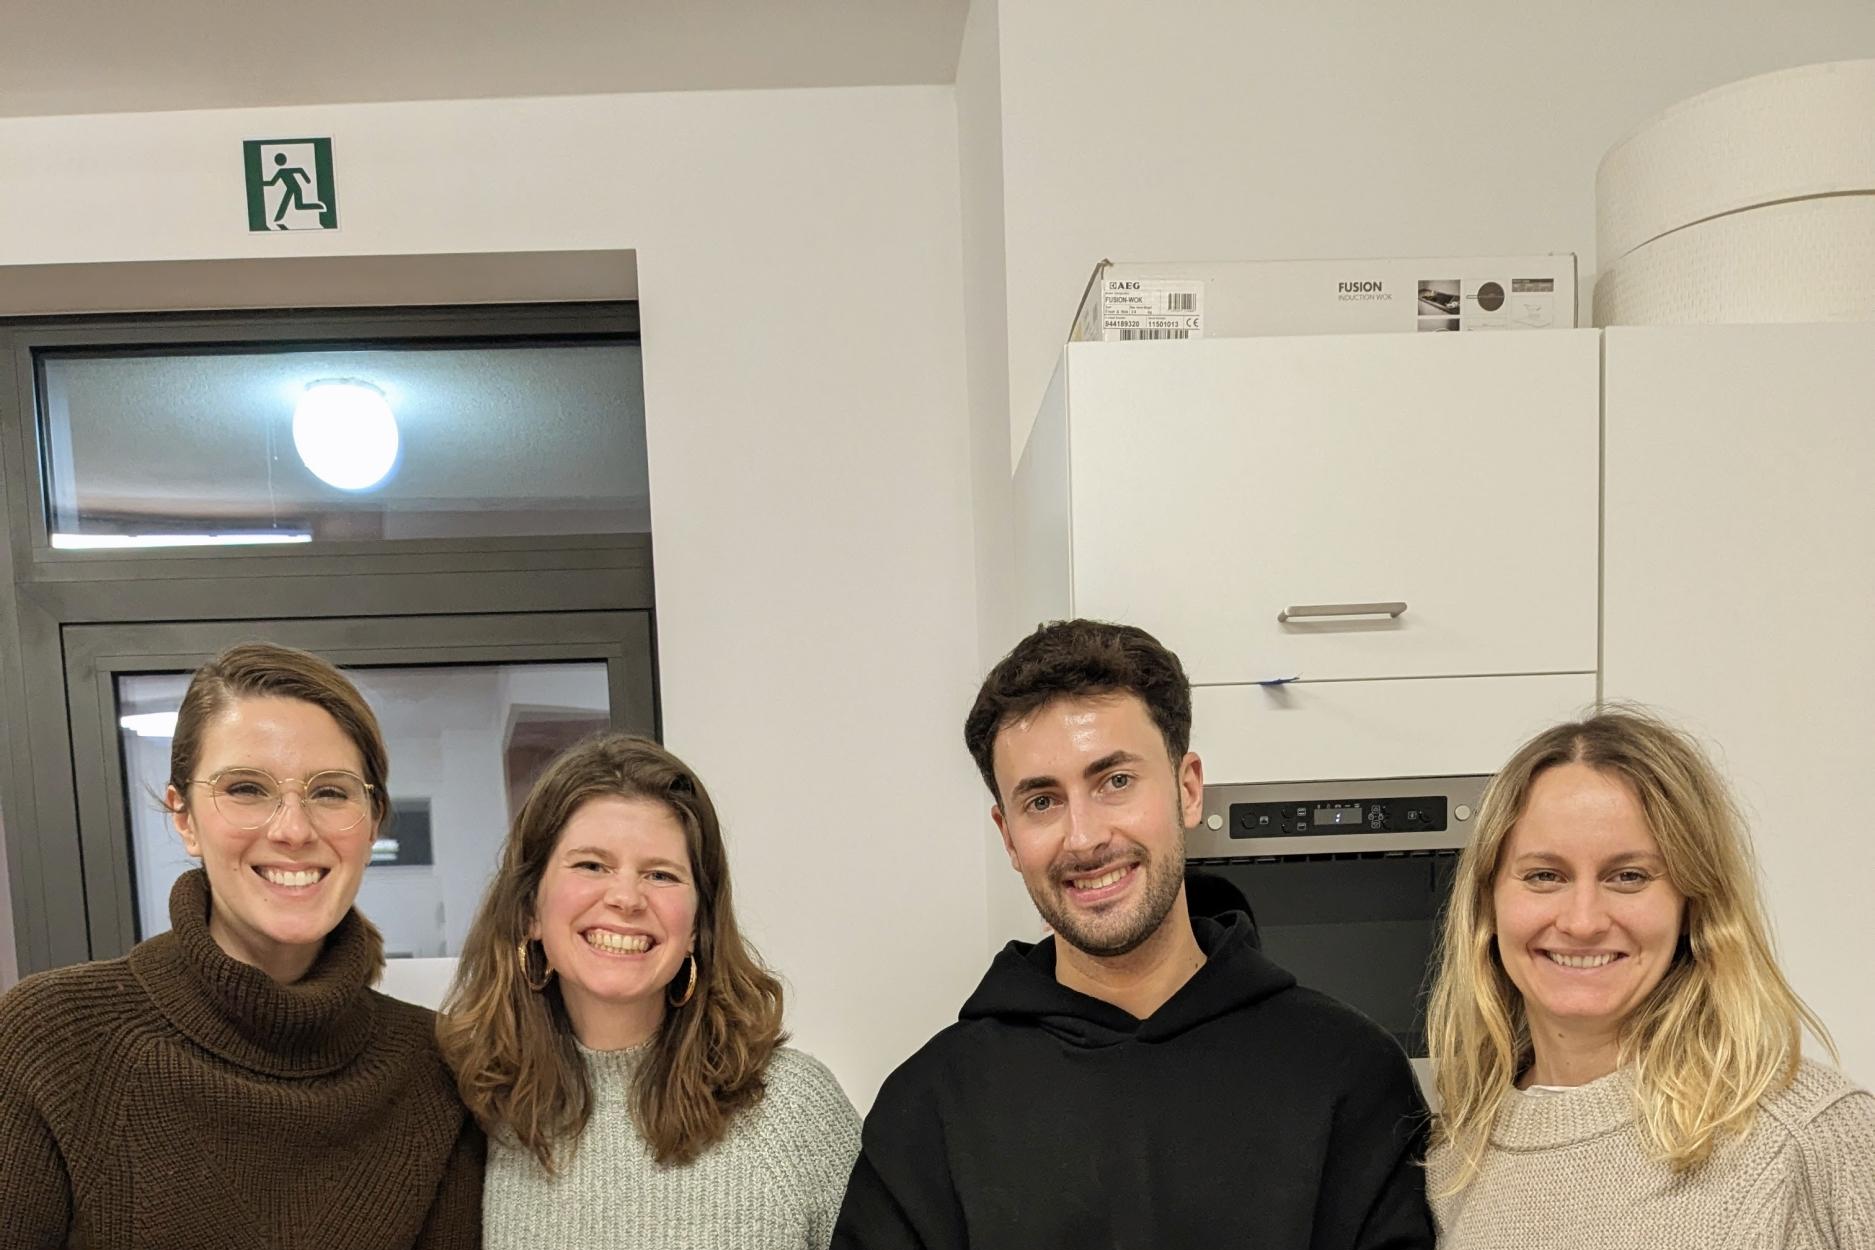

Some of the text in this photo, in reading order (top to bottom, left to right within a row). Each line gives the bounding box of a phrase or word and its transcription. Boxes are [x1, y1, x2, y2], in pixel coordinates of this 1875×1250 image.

[1118, 281, 1140, 290] AEG
[1338, 281, 1382, 293] FUSION
[1105, 296, 1143, 304] FUSION-WOK
[1338, 293, 1393, 301] INDUCTION WOK
